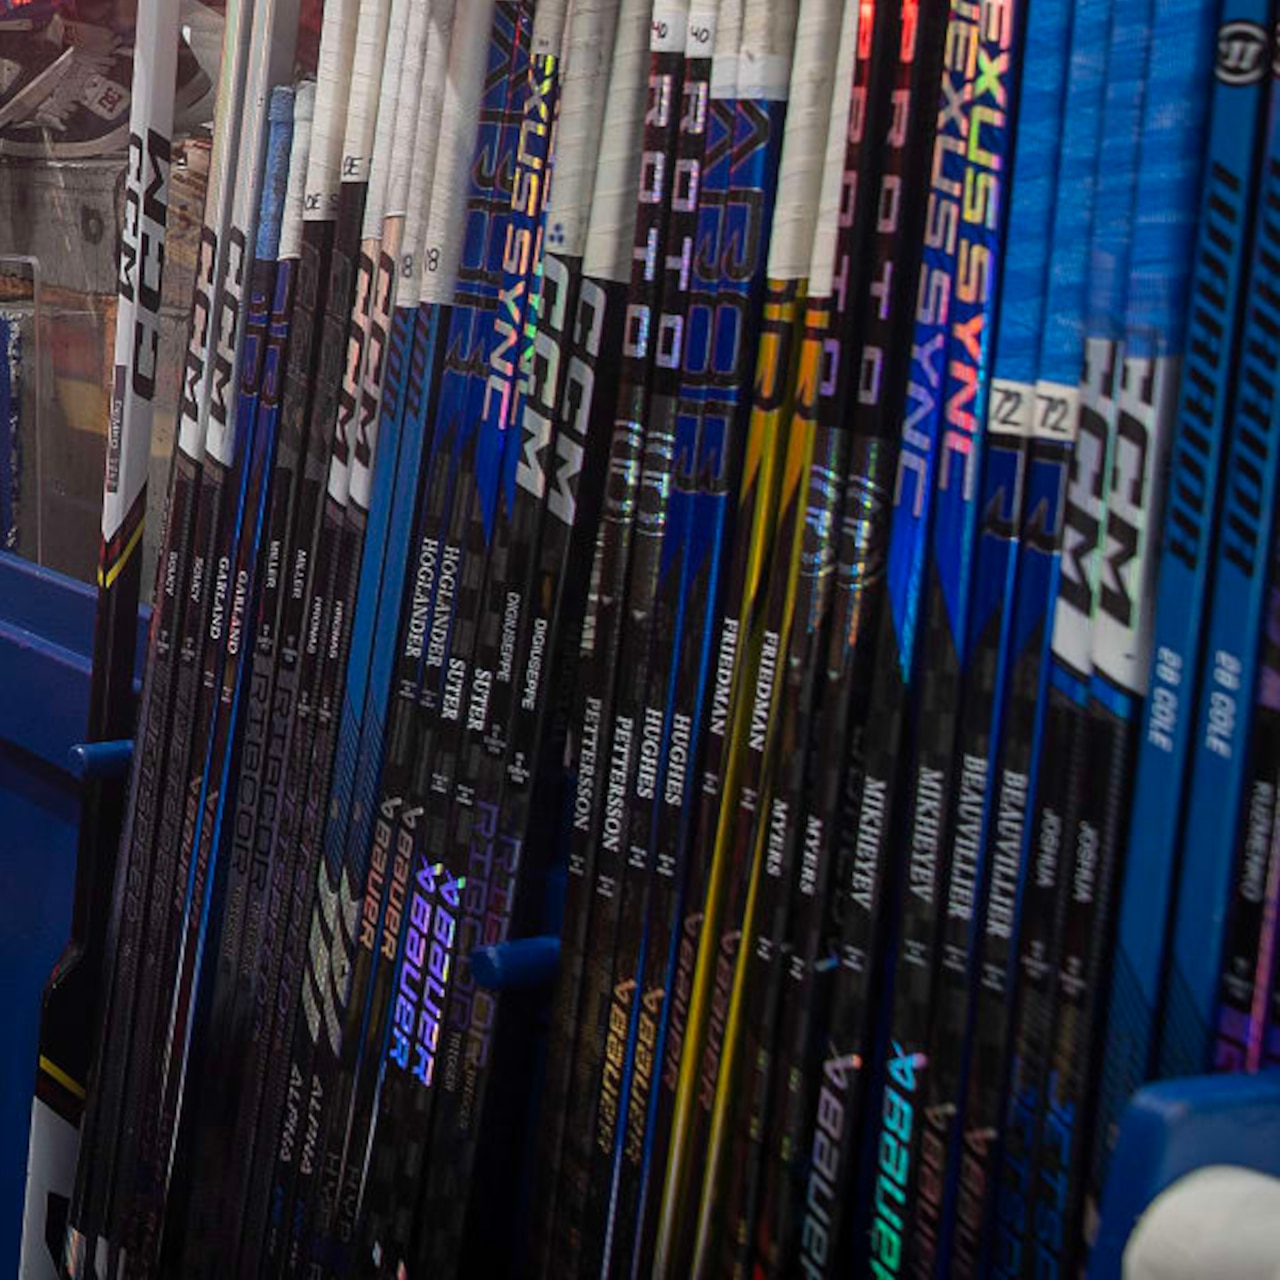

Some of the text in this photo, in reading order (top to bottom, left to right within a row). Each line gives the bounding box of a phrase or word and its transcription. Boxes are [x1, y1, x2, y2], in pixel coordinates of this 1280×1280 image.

[691, 25, 710, 43] 40
[132, 127, 171, 401] CCM
[179, 225, 218, 423] CCM
[208, 225, 247, 425] CCM
[481, 223, 530, 431] SYNC
[516, 253, 571, 500] CCM
[938, 238, 993, 502] SYNC
[546, 277, 607, 526] CCM
[893, 263, 951, 519] SYNC
[992, 388, 1024, 427] 72
[1039, 396, 1071, 435] 72
[209, 556, 231, 640] GARLAND
[227, 570, 249, 655] GARLAND
[265, 540, 281, 589] MILLER
[292, 549, 308, 599] MILLER
[405, 537, 439, 658] HOGLANDER
[426, 545, 460, 667] HOGLANDER
[441, 658, 466, 720] SUTER
[497, 591, 522, 683] DIGIUSEPPE
[522, 618, 548, 712] DIGIUSEPPE
[710, 616, 739, 737] FRIEDMAN
[748, 630, 779, 753] FRIEDMAN
[466, 668, 492, 732] SUTER
[636, 707, 663, 800] HUGHES
[664, 712, 691, 807] HUGHES
[573, 696, 602, 832] PETTERSSON
[602, 715, 634, 853] PETTERSSON
[359, 819, 392, 951] BAUER
[381, 828, 414, 960] BAUER
[767, 798, 788, 878] MYERS
[800, 814, 823, 896] MYERS
[851, 775, 888, 912] MIKHEYEV
[910, 765, 944, 905] MIKHEYEV
[948, 752, 990, 921] BEAUVILLIER
[986, 768, 1029, 939] BEAUVILLIER
[1036, 807, 1062, 888] JOSHUA
[1073, 819, 1099, 904] JOSHUA
[390, 891, 432, 1070] BAUER
[412, 904, 456, 1087] BAUER
[472, 834, 523, 1067] RIBOR
[279, 1061, 303, 1162] ALPHA
[299, 1073, 324, 1175] ALPHA
